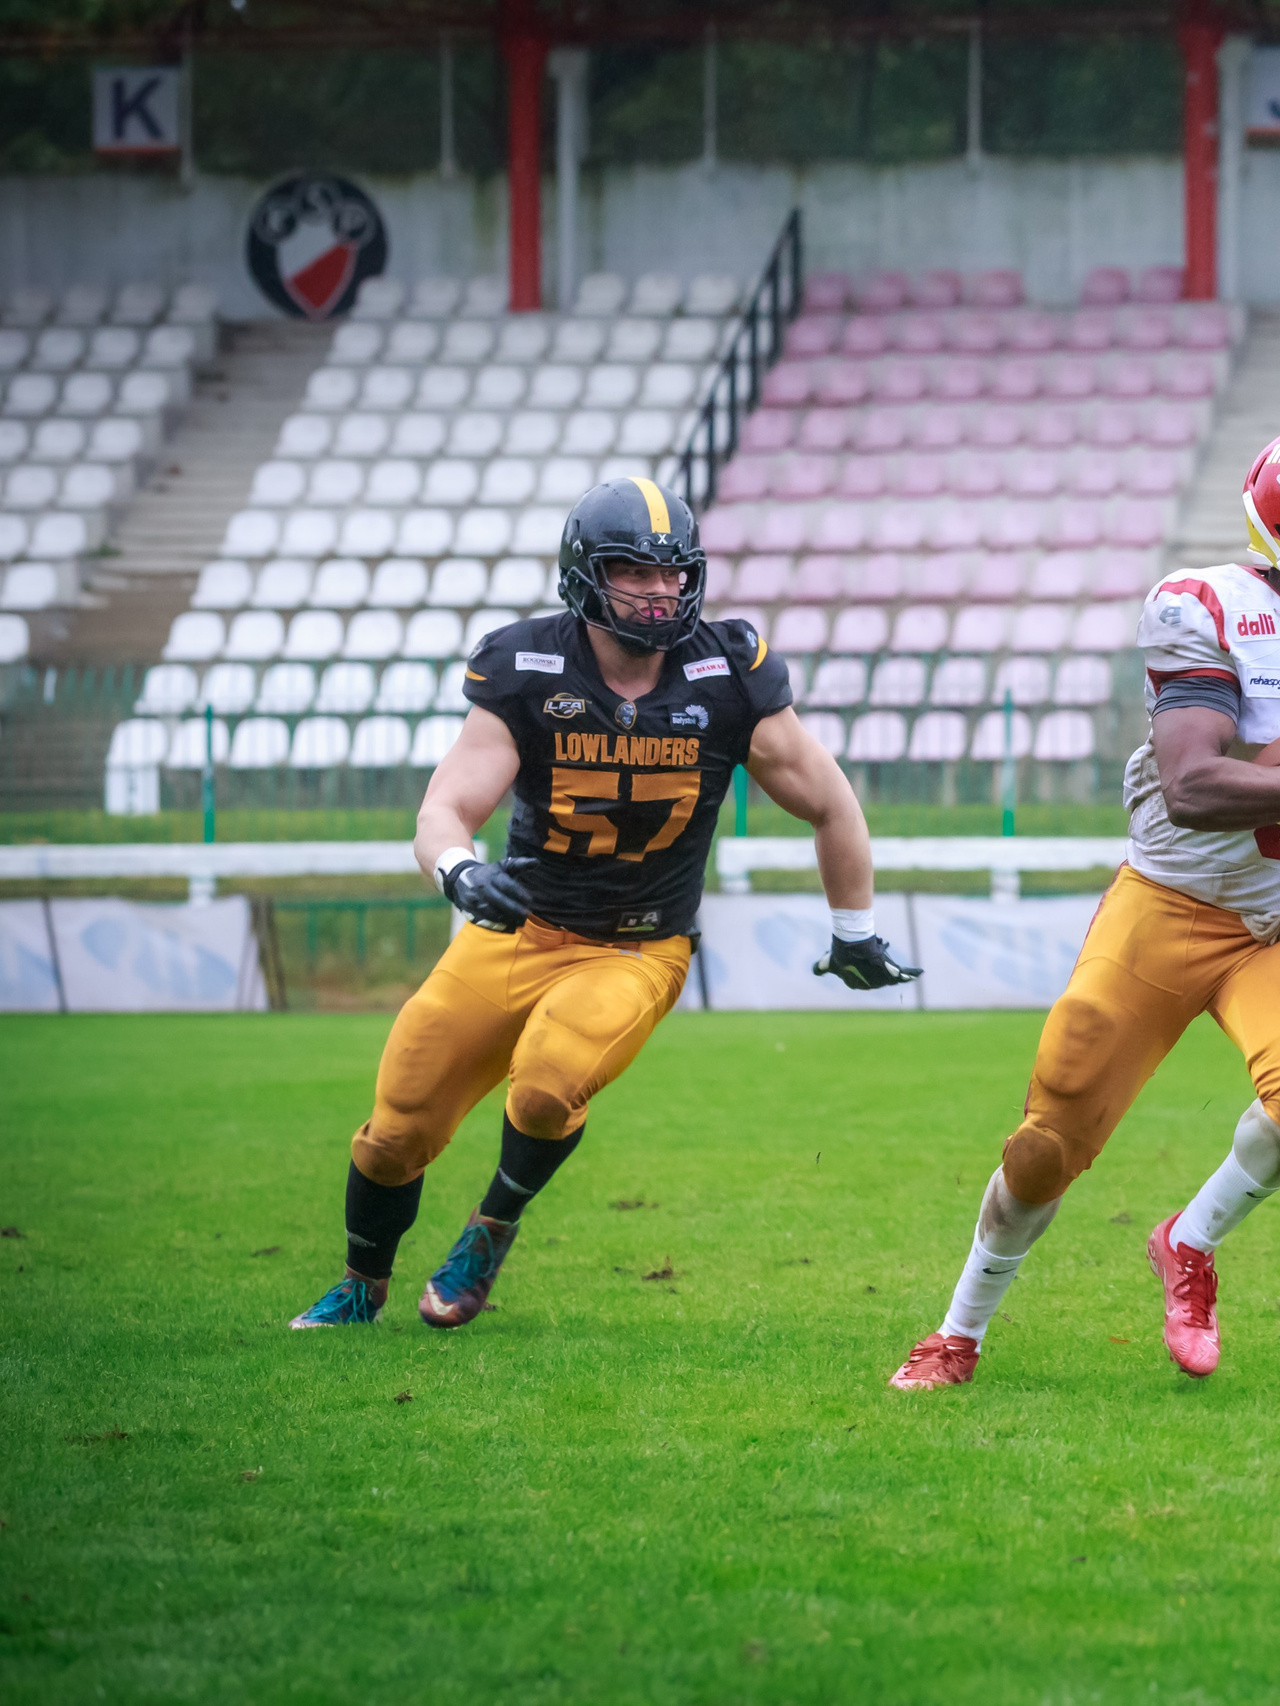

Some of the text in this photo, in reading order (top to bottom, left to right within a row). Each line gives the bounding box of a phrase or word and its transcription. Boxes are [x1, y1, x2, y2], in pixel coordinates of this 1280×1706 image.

[113, 77, 164, 140] K
[1236, 612, 1277, 637] dalli
[547, 701, 583, 711] LFA
[554, 732, 700, 766] LOWLANDERS
[543, 767, 701, 862] 57
